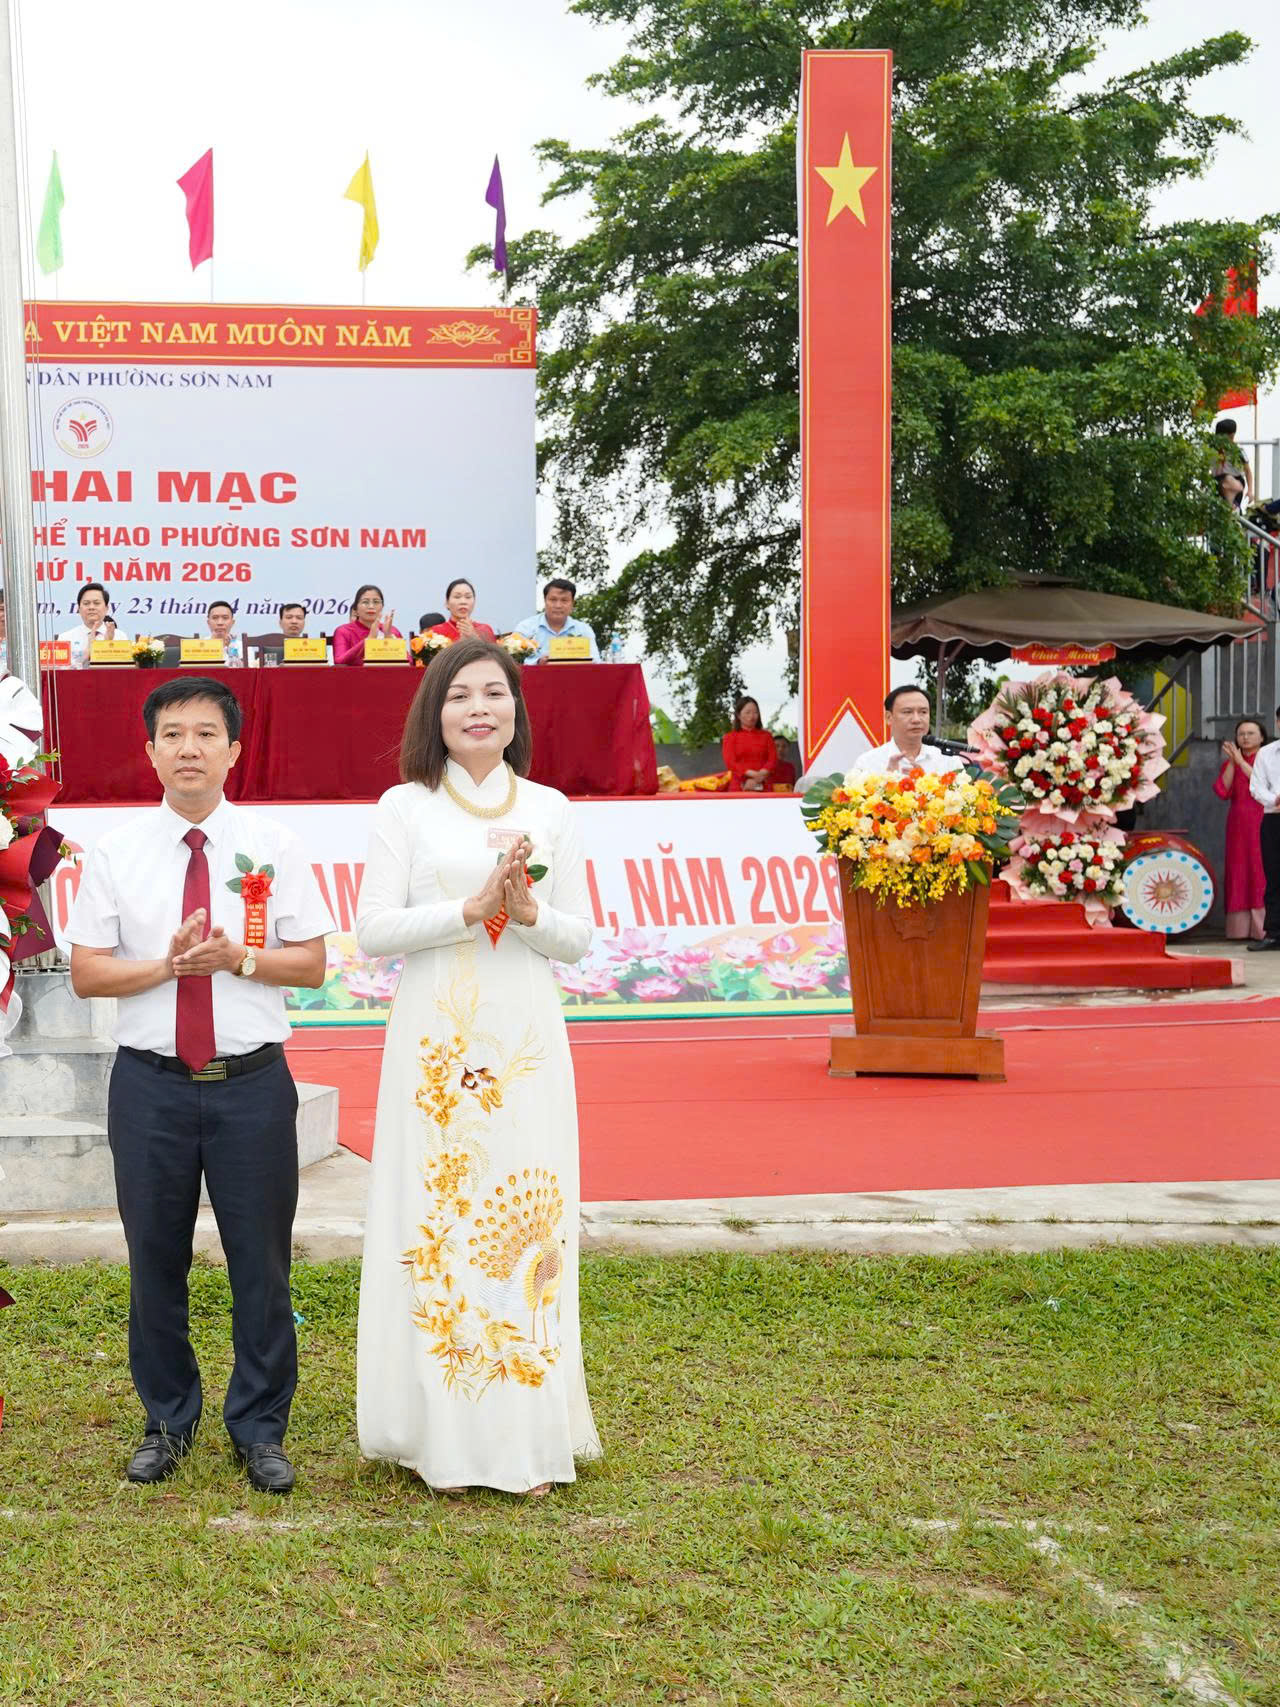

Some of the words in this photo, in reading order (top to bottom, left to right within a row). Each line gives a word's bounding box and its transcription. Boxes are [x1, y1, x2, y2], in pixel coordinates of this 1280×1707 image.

[52, 313, 132, 349] VIỆT
[140, 321, 218, 345] NAM
[226, 318, 327, 347] MUÔN
[335, 320, 412, 348] NĂM
[38, 366, 80, 386] DÂN
[87, 369, 174, 387] PHƯỜNG
[179, 371, 220, 387] SƠN
[226, 373, 273, 388] NAM
[157, 471, 297, 511] MẠC
[32, 517, 66, 547] HỂ
[76, 526, 150, 547] THAO
[161, 521, 280, 548] PHƯỜNG
[290, 525, 350, 548] SƠN
[360, 528, 427, 549] NAM
[75, 562, 93, 585] I,
[103, 556, 172, 583] NĂM
[181, 562, 252, 583] 2026
[127, 597, 153, 615] 23
[159, 597, 209, 615] thán
[304, 597, 349, 615] 2026
[585, 858, 620, 937] I,
[624, 842, 737, 928] NĂM
[741, 854, 844, 925] 2026
